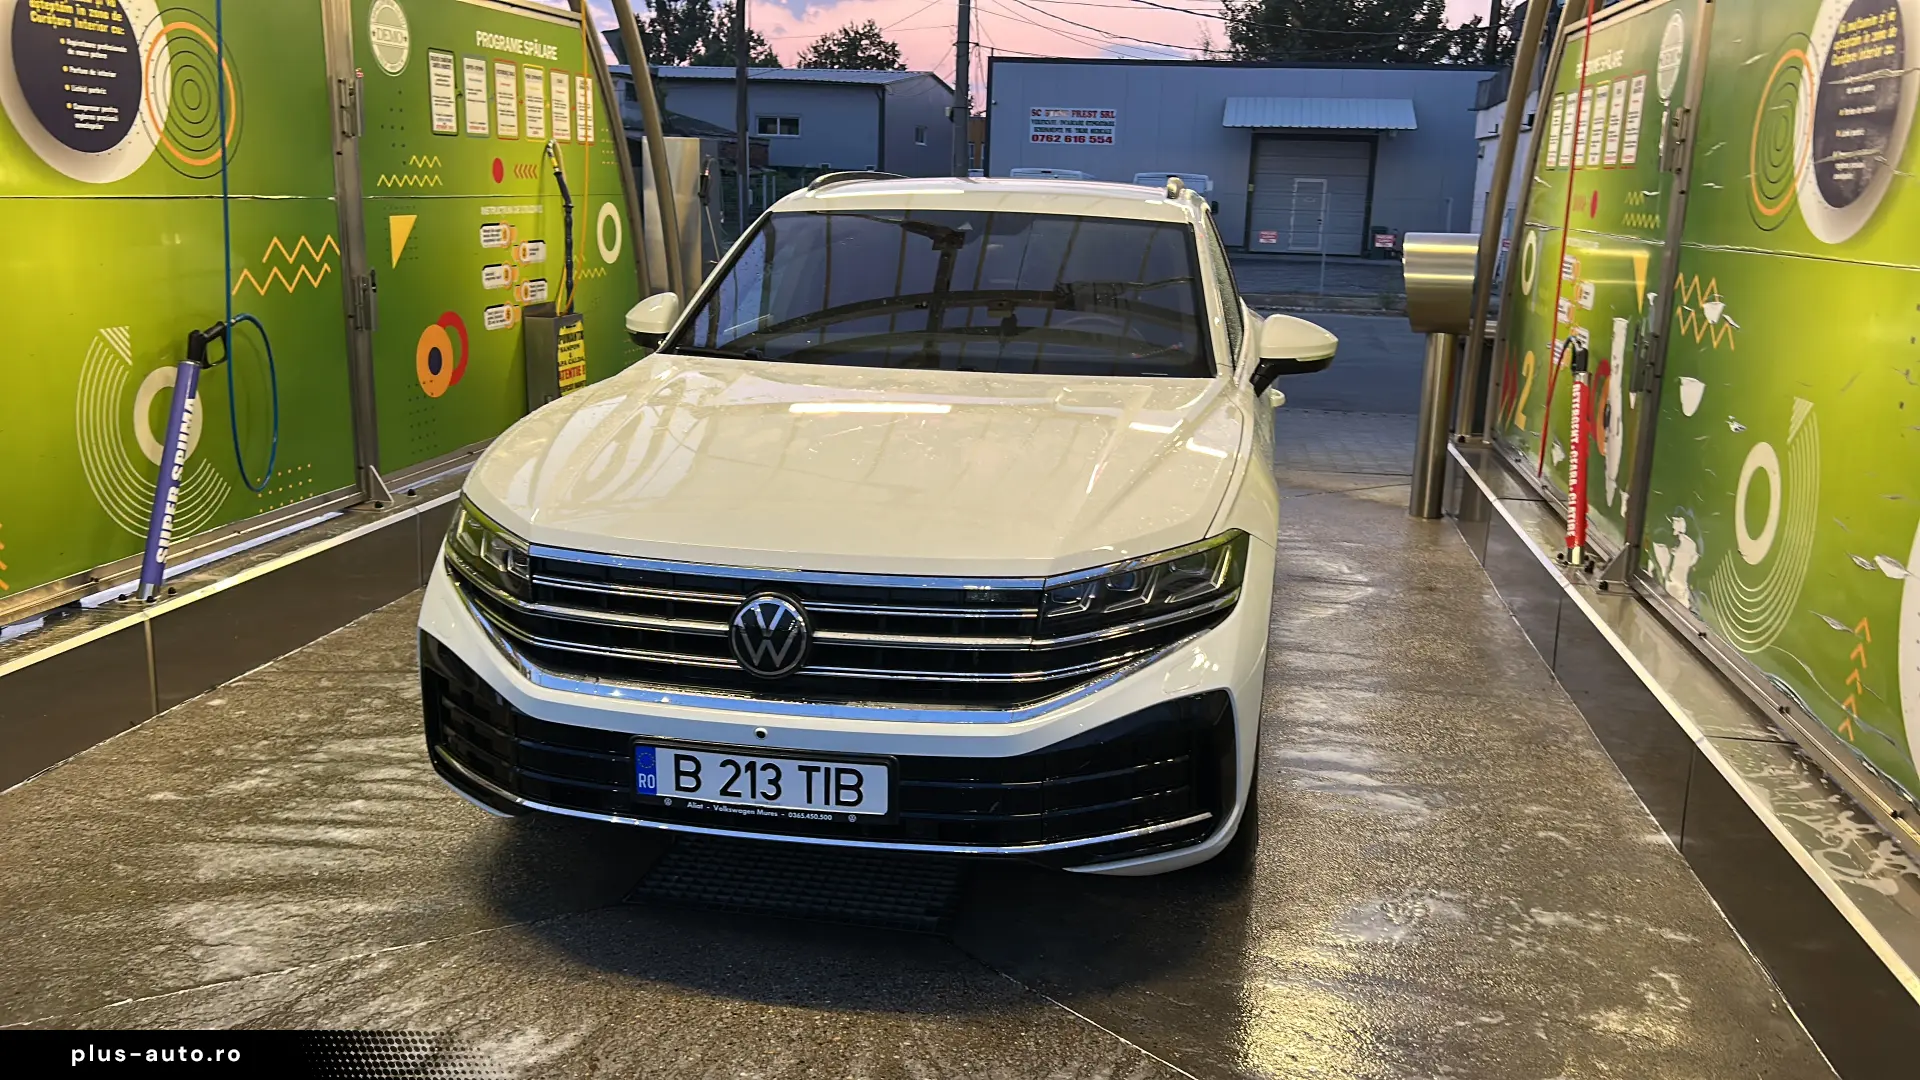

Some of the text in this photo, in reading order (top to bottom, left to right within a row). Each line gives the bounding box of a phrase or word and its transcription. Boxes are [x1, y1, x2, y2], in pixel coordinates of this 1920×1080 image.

[111, 11, 123, 22] de
[475, 30, 524, 55] PROGRAME
[1031, 109, 1042, 117] SC
[1071, 110, 1098, 119] PREST
[1100, 111, 1115, 119] SRL
[1031, 134, 1113, 144] 0762 616 554
[156, 398, 196, 564] SUPER SPUMA
[638, 773, 656, 789] RO
[673, 753, 864, 807] B 213 TIB
[713, 804, 755, 815] Volkswagen
[756, 808, 778, 817] Mures
[788, 811, 833, 821] 0365.450.500
